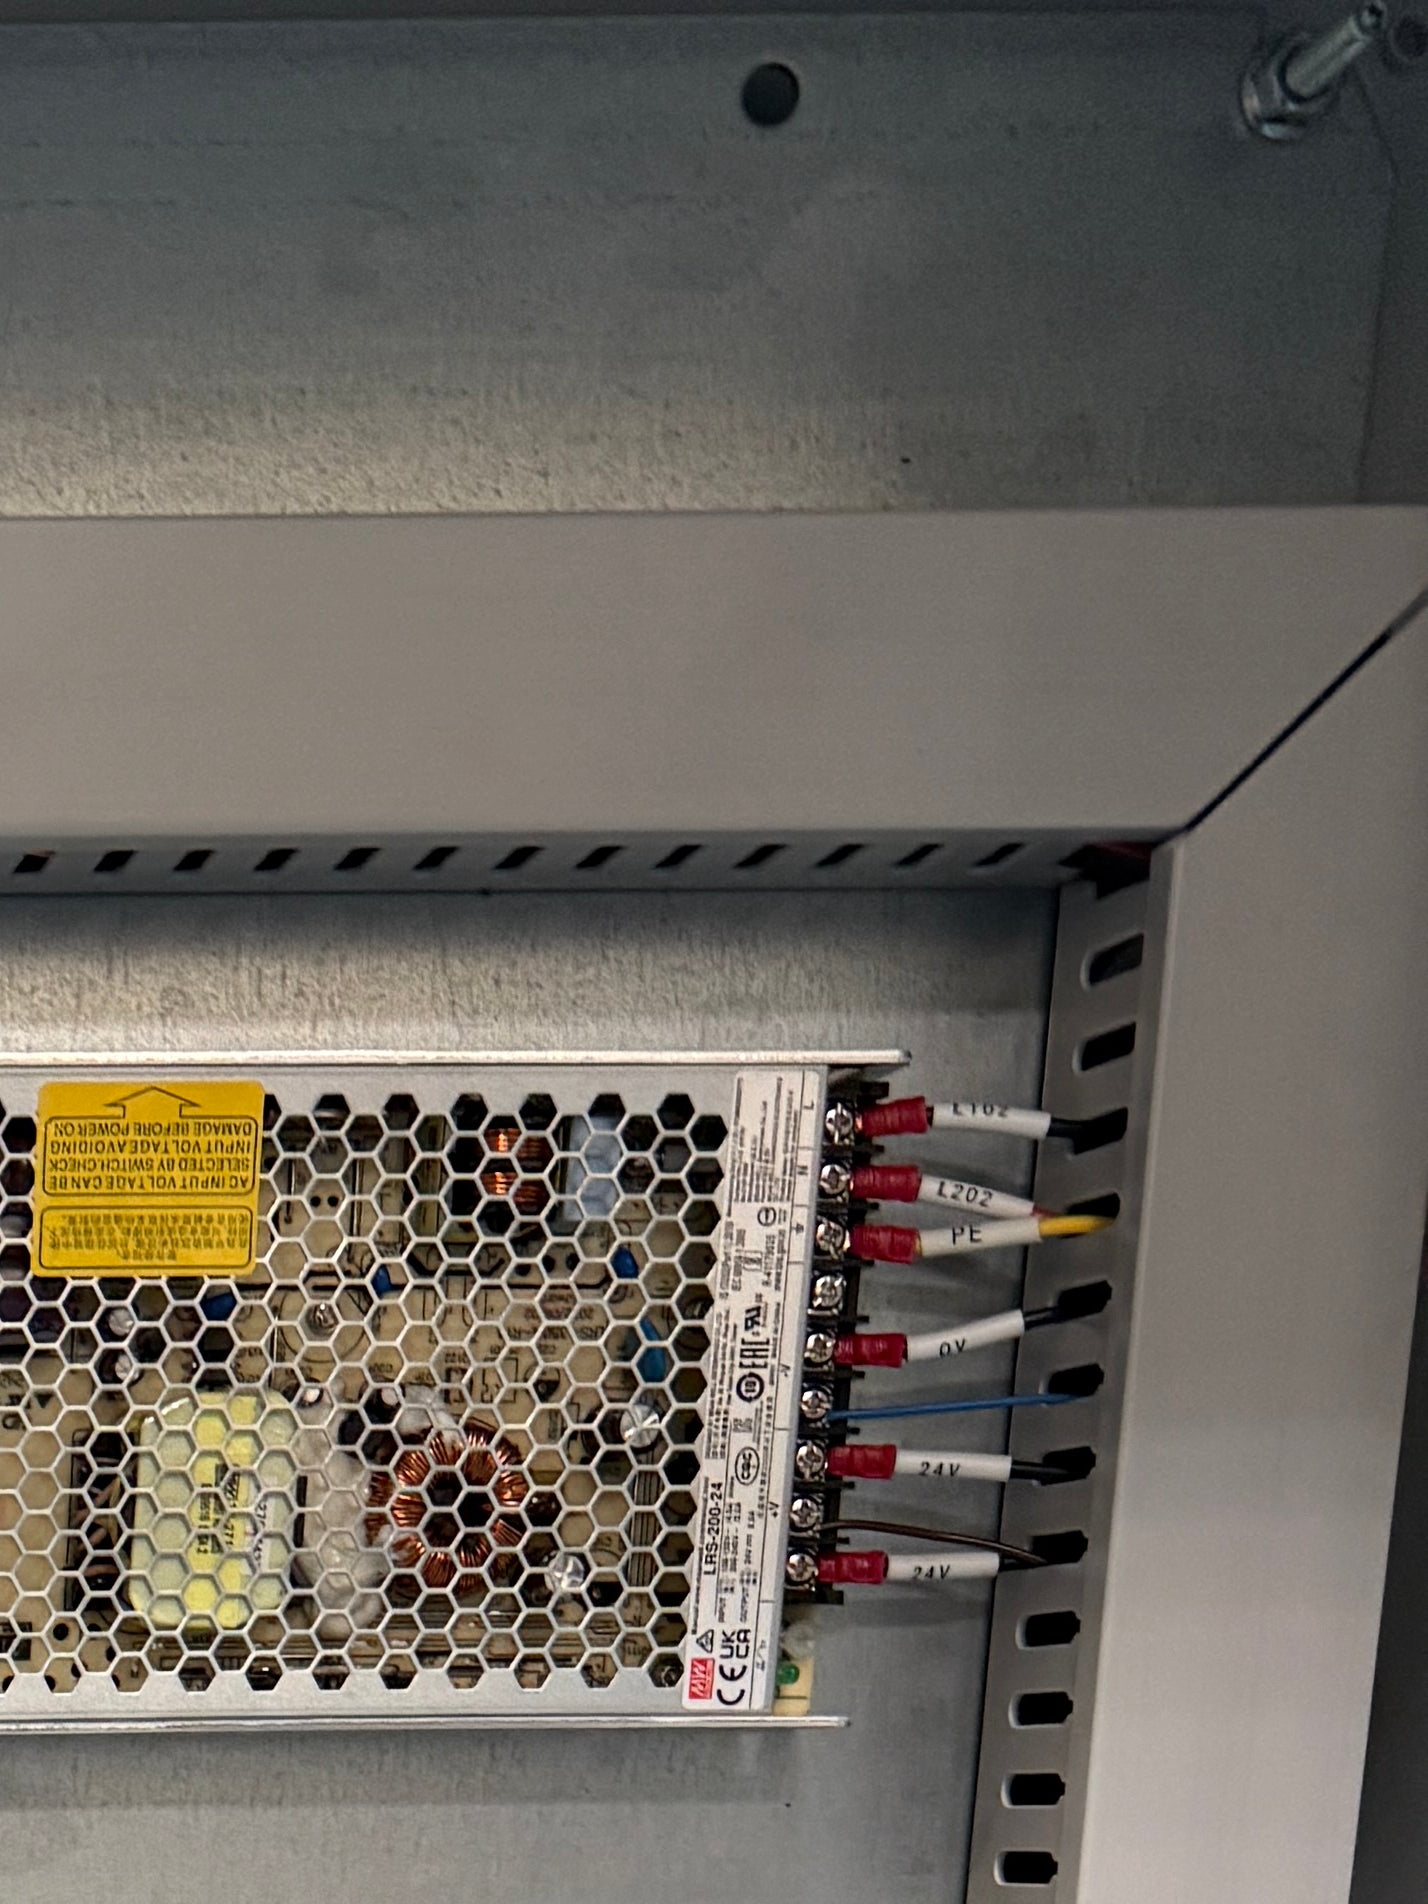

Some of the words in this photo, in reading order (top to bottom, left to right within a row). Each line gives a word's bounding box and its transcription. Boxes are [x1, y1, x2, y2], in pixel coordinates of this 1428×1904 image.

[80, 1121, 130, 1137] POWER
[133, 1121, 190, 1137] BEFORE
[194, 1121, 252, 1136] DAMAGE
[50, 1139, 127, 1154] AVOIDING
[131, 1139, 201, 1154] VOLTAGE
[204, 1139, 250, 1154] INPUT
[179, 1157, 250, 1172] SELECTED
[70, 1175, 102, 1189] CAN
[185, 1176, 226, 1190] INPUT
[936, 1180, 994, 1208] L202
[951, 1224, 983, 1246] PE
[939, 1338, 967, 1357] 0V
[919, 1461, 961, 1477] 24V
[703, 1481, 722, 1576] LRS-200-24
[913, 1564, 951, 1580] 24V
